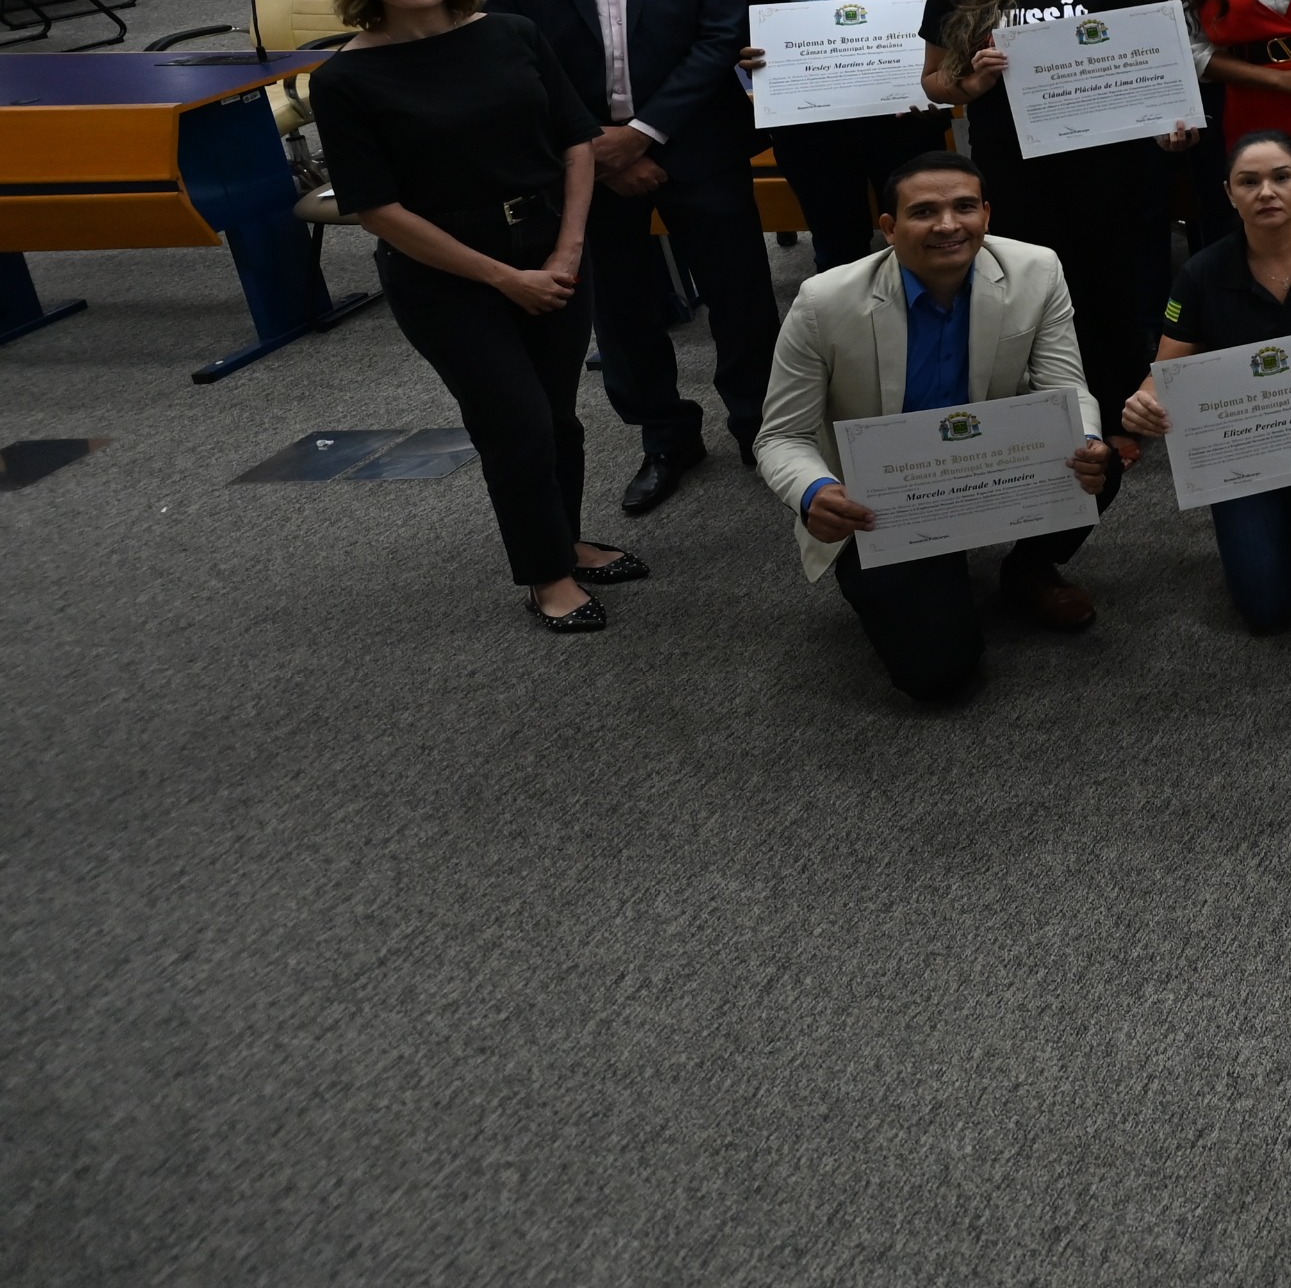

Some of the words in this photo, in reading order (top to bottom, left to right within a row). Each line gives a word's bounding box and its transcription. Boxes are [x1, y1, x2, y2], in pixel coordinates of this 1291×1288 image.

[805, 64, 832, 72] Wesley
[833, 61, 865, 70] Martins
[866, 59, 876, 67] de
[877, 58, 901, 66] Sousa
[1042, 89, 1073, 100] Cláudia
[1074, 84, 1103, 95] Plácido
[1103, 82, 1113, 90] de
[1114, 79, 1134, 88] Lima
[1135, 74, 1165, 84] Oliveira
[1223, 427, 1253, 439] Elizete
[1255, 419, 1287, 432] Pereira
[906, 489, 946, 502] Marcelo
[948, 481, 989, 495] Andrade
[992, 473, 1035, 486] Monteiro
